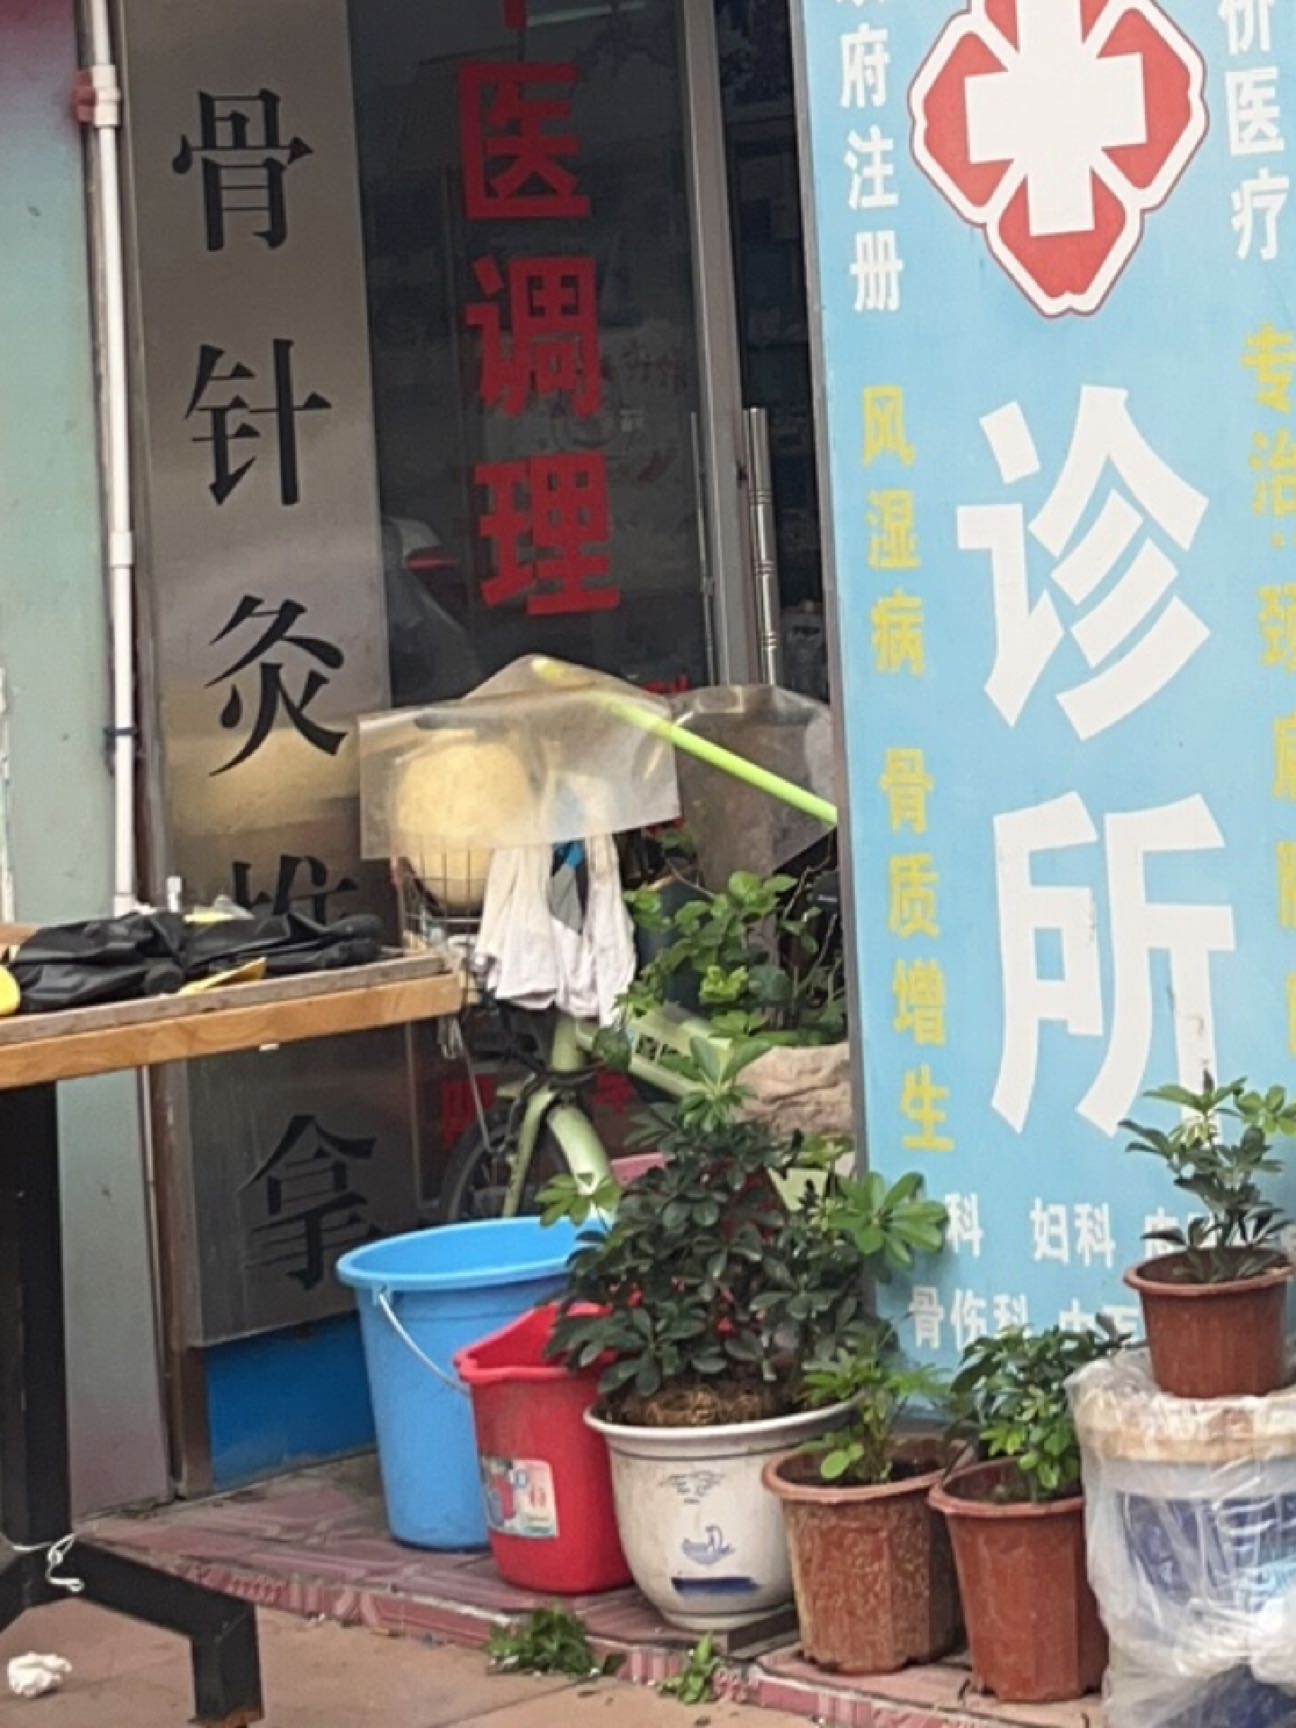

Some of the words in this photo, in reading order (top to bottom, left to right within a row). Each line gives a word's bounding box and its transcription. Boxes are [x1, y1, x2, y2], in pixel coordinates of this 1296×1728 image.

[861, 384, 925, 676] 风湿病
[955, 384, 1238, 1139] 诊所
[880, 746, 955, 1154] 骨质增生
[1030, 1196, 1116, 1269] 妇科
